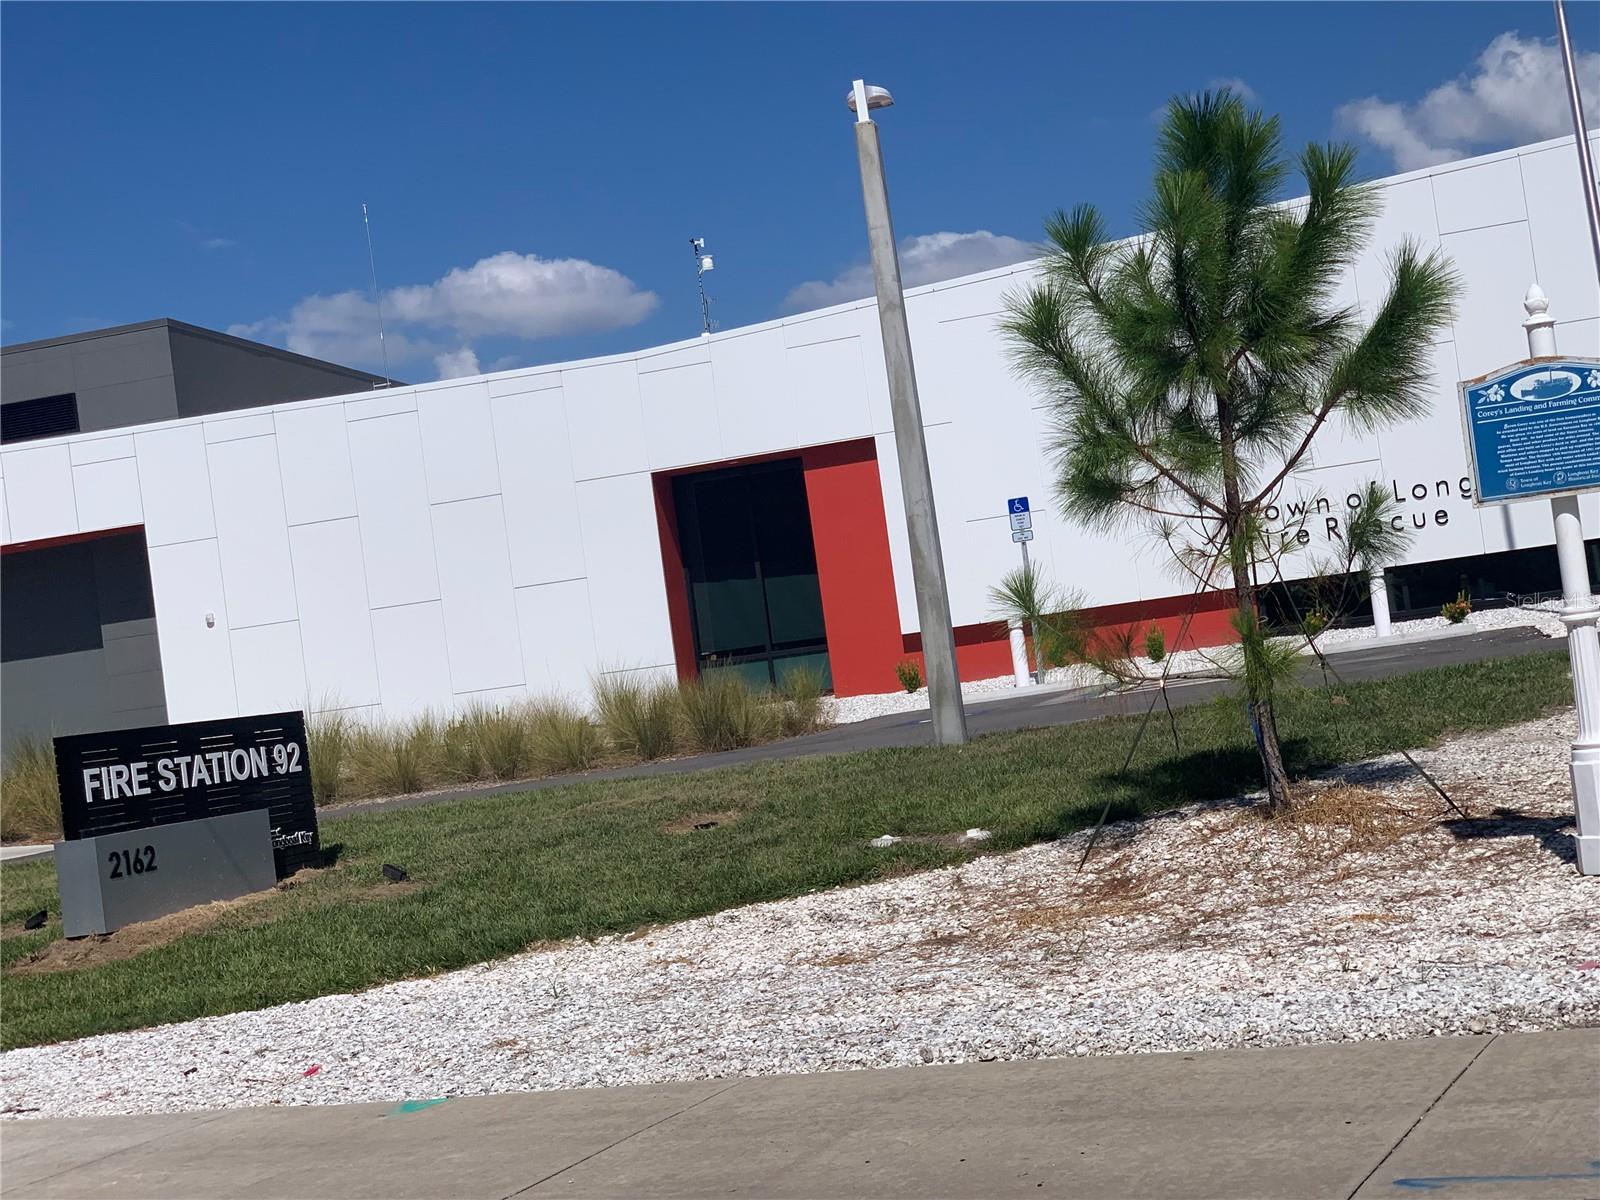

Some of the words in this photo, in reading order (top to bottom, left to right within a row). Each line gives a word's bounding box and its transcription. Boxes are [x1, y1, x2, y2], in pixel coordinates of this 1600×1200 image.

[1478, 408, 1503, 417] Corey's
[1504, 404, 1533, 414] Landing
[1534, 401, 1547, 410] and
[1549, 398, 1577, 408] Farming
[1262, 496, 1330, 521] own
[1264, 527, 1310, 550] ire
[1325, 508, 1449, 542] Rcue
[83, 761, 151, 803] FIRE
[157, 745, 269, 792] STATION
[273, 742, 302, 775] 92
[108, 845, 157, 879] 2162
